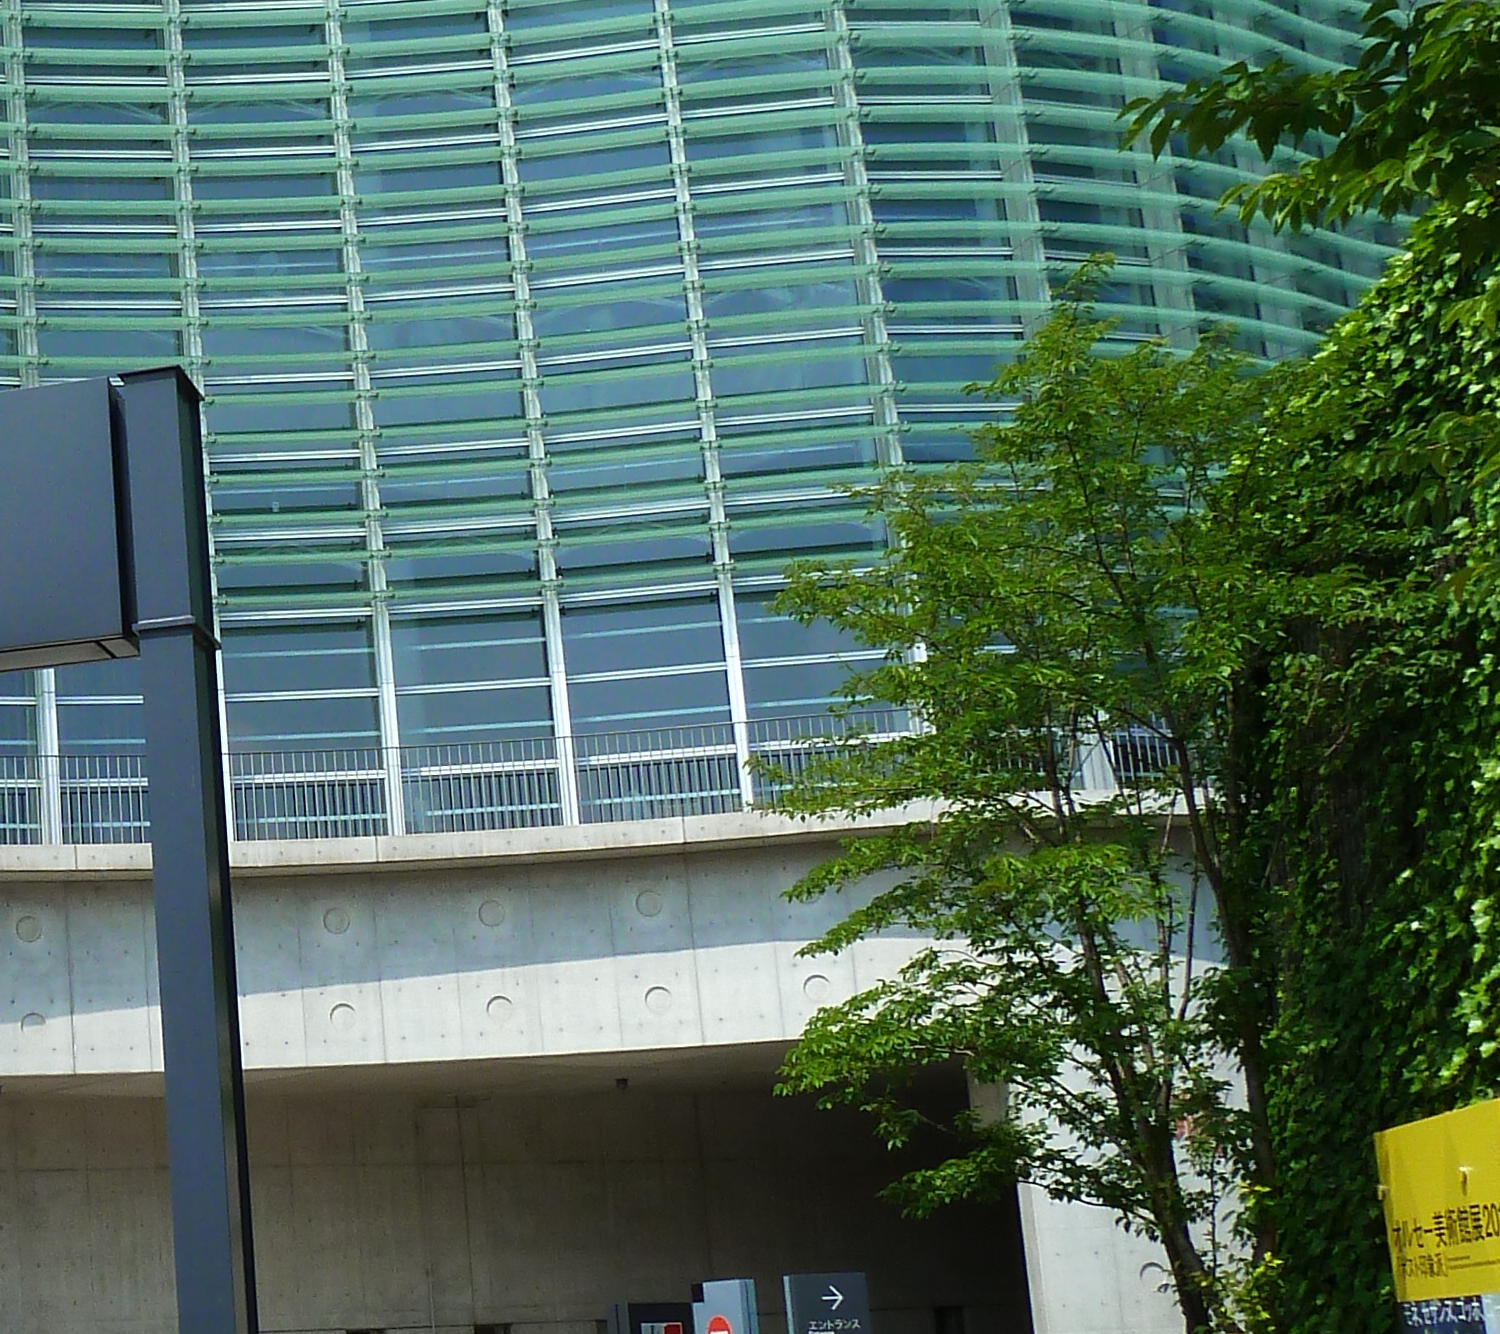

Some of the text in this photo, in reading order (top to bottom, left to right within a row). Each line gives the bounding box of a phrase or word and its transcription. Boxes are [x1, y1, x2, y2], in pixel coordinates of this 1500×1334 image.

[1392, 1203, 1500, 1253] オルセー美術館展20
[808, 1318, 861, 1330] エントランス
